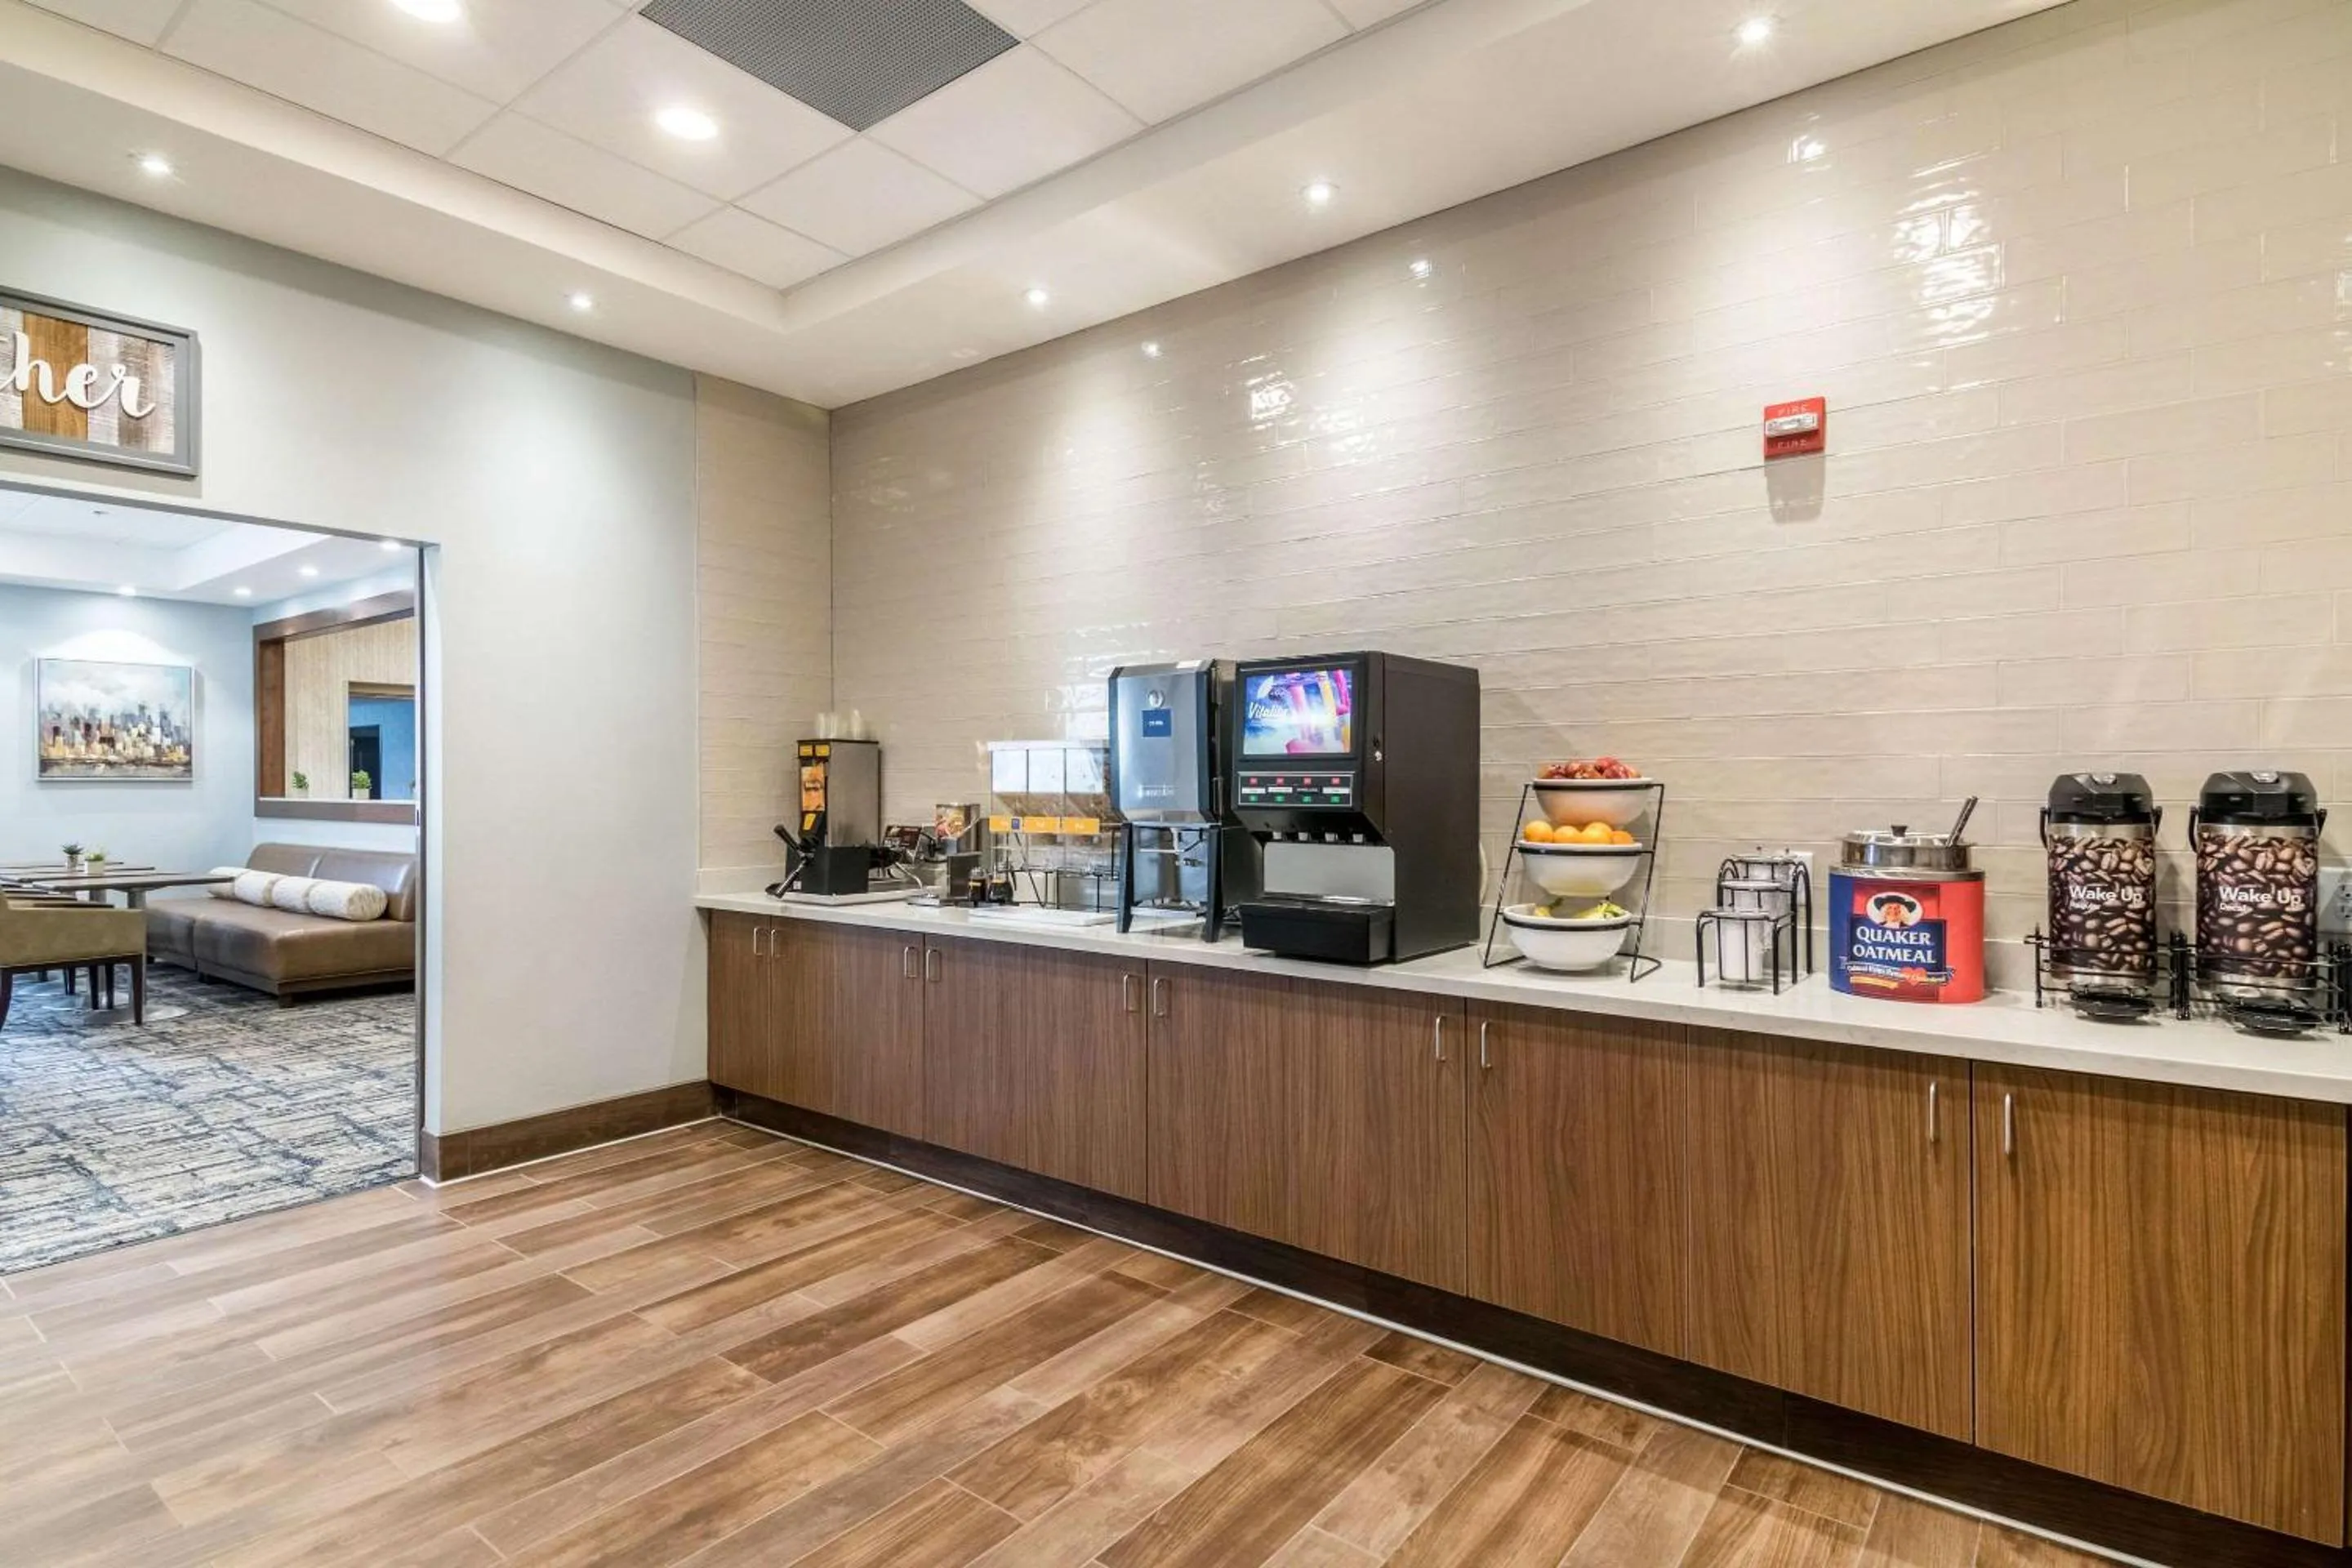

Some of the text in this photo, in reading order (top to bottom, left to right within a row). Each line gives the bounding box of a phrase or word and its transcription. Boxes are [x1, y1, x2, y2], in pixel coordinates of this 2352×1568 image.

[0, 330, 156, 419] her
[2069, 885, 2143, 906] Wake Up
[2218, 885, 2301, 908] Wake Up
[1856, 926, 1931, 945] QUAKER
[1852, 944, 1937, 964] OATMEAL
